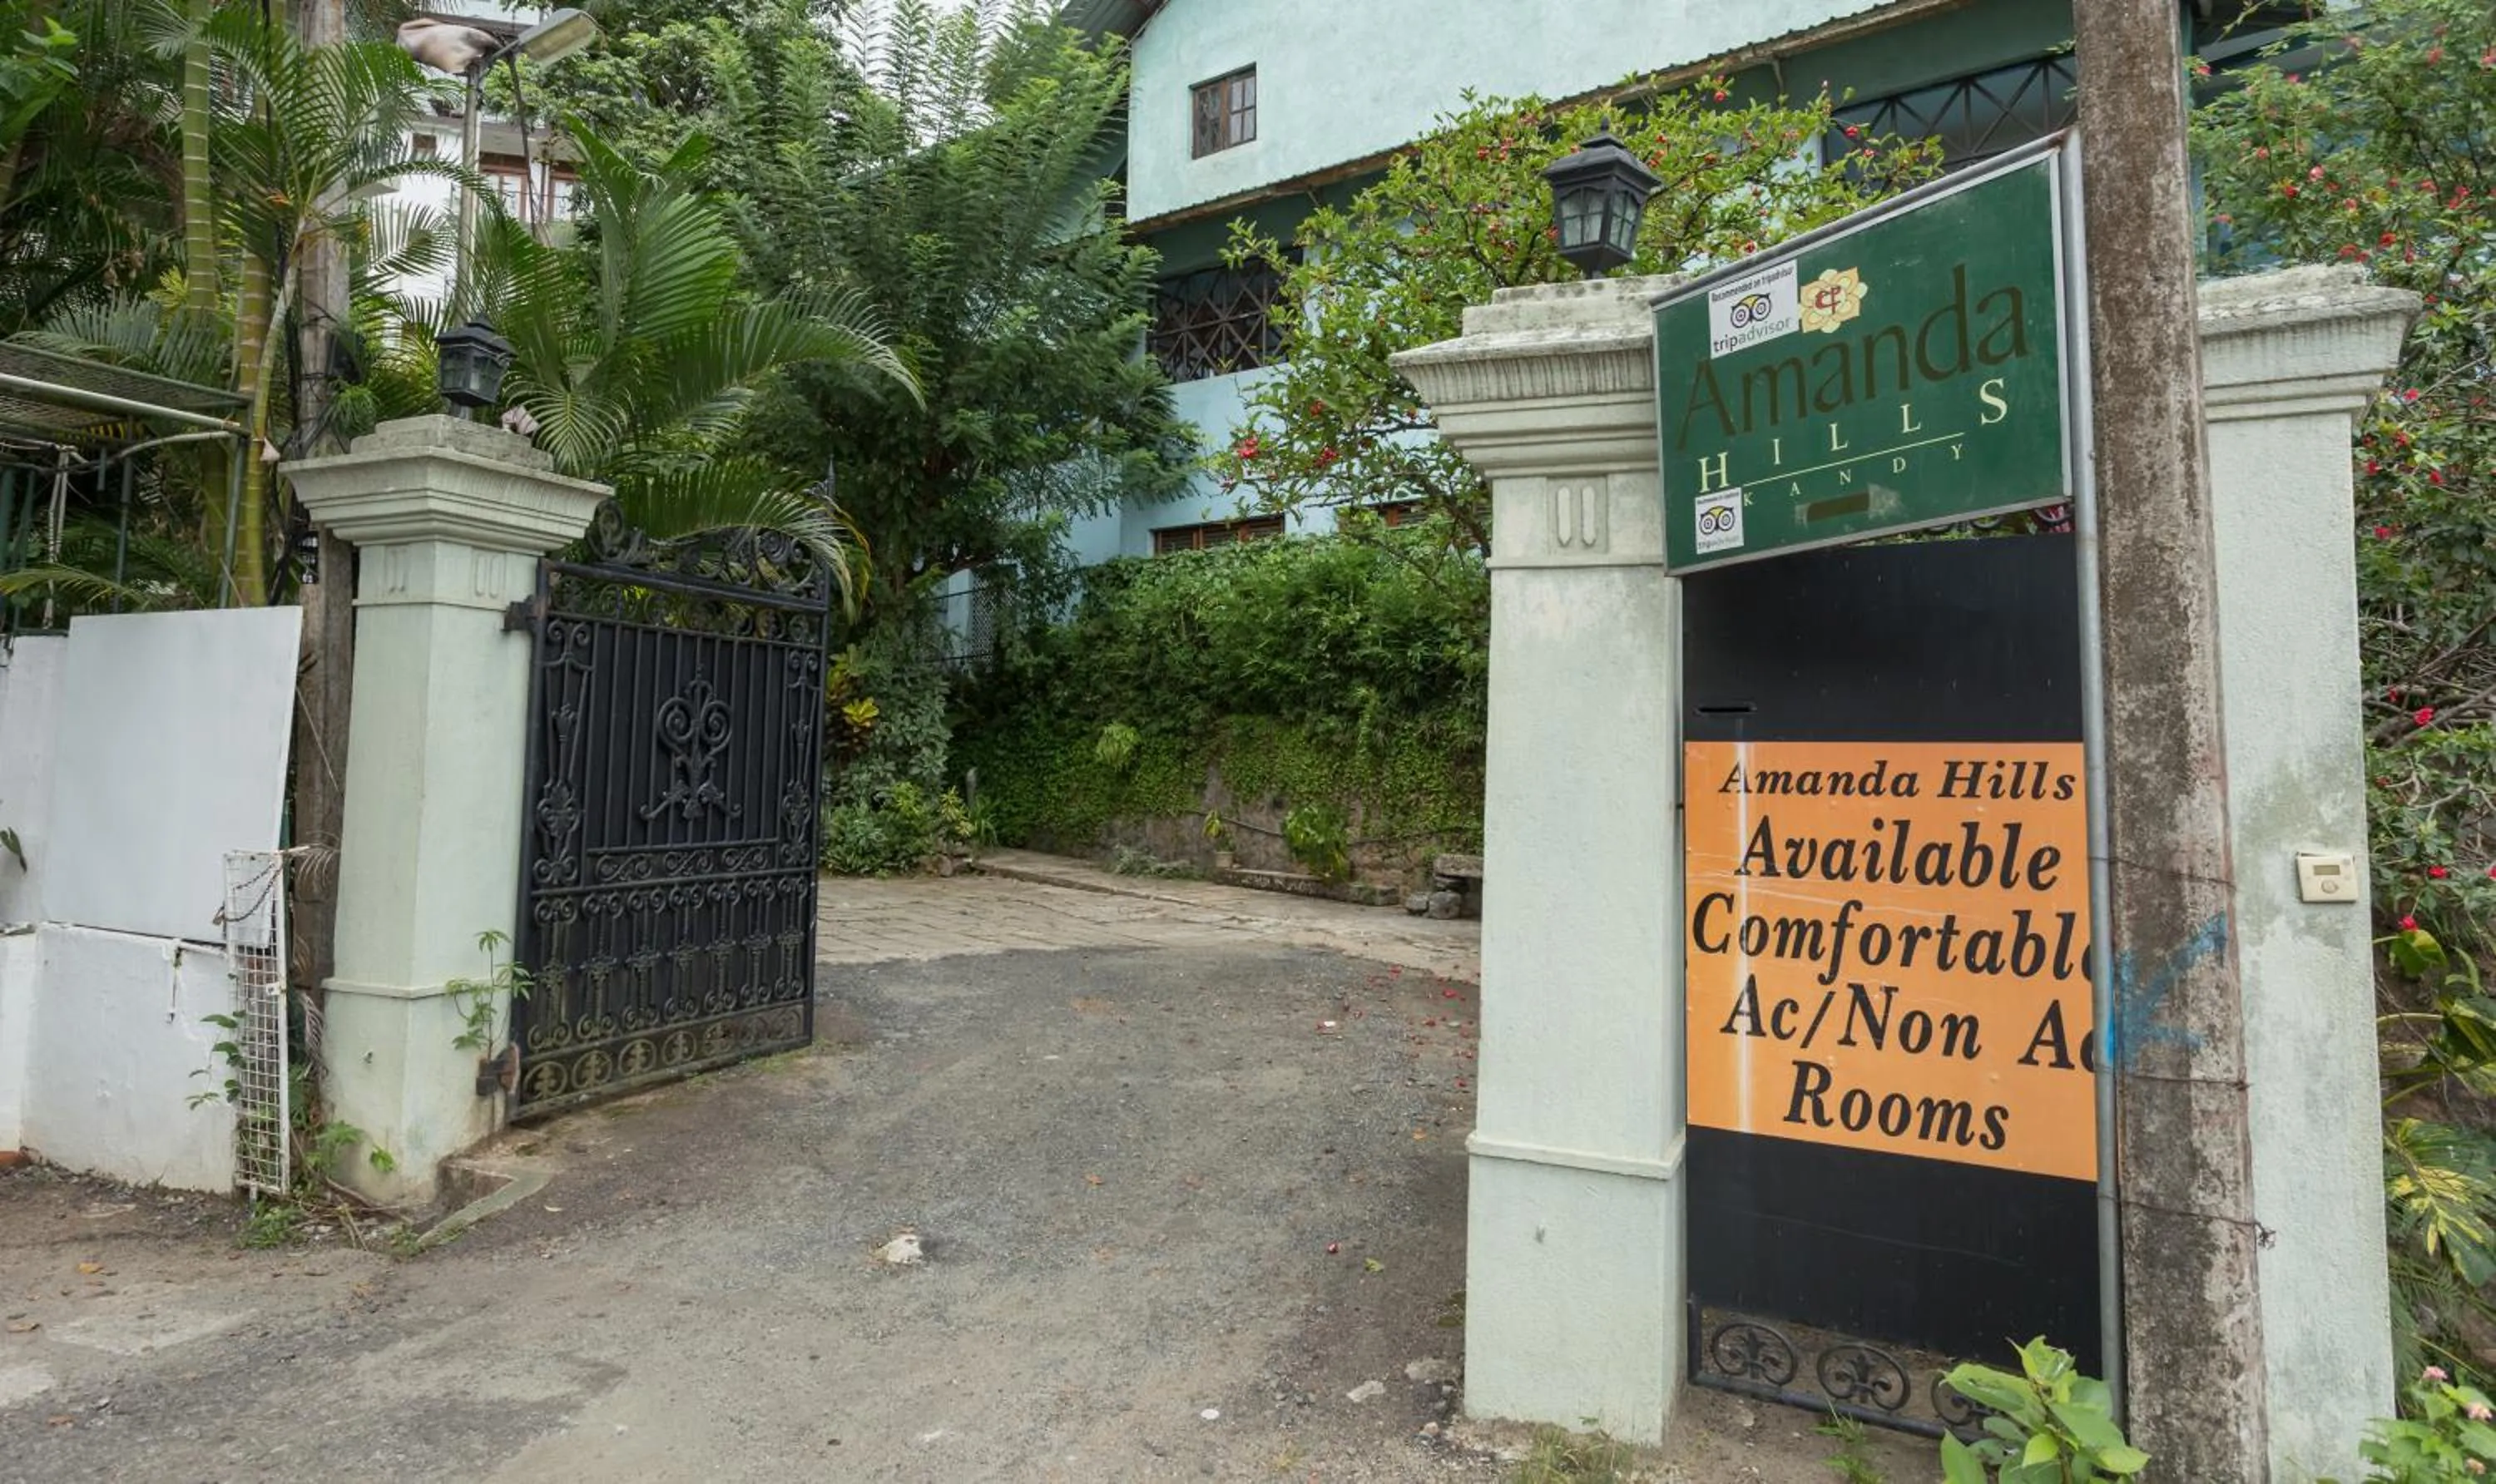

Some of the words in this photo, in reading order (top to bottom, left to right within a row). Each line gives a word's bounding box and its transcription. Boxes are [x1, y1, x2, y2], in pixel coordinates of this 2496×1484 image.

[1675, 263, 2030, 453] Amanda
[1713, 318, 1790, 353] tripadvisor
[1697, 377, 2009, 493] HILLS
[1743, 443, 1966, 507] KANDY
[1719, 759, 1919, 798] Amanda
[1936, 759, 2076, 801] Hills
[1734, 814, 2061, 891] Available
[1692, 892, 2092, 986] Comfortabl
[1720, 973, 1982, 1060] Ac/Non
[1783, 1060, 2009, 1150] Rooms
